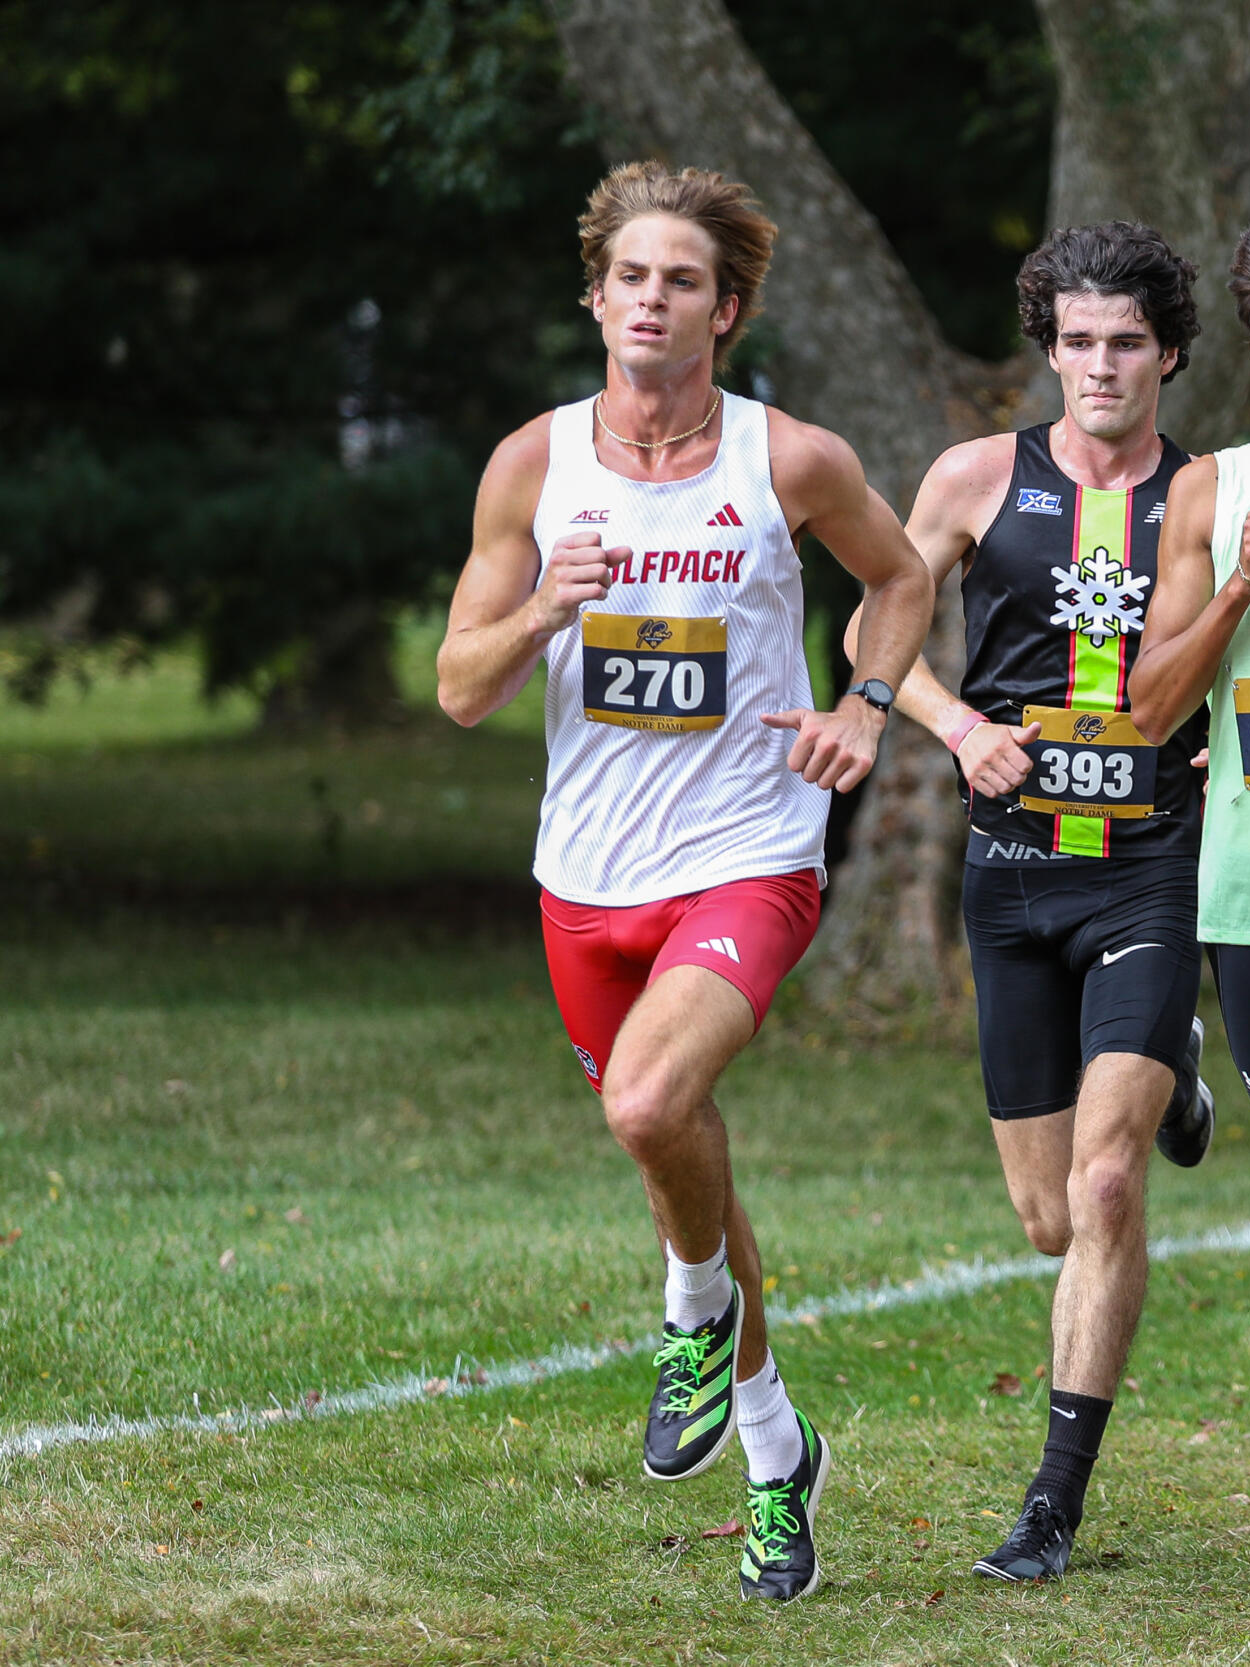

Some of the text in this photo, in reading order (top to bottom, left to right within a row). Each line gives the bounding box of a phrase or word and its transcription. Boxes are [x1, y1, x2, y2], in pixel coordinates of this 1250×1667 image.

[572, 509, 611, 521] ACC
[611, 549, 747, 585] LFPACK
[604, 656, 705, 711] 270
[622, 718, 685, 732] NOTRE DAME
[1039, 747, 1134, 799] 393
[1055, 806, 1115, 818] NOTRE DAME
